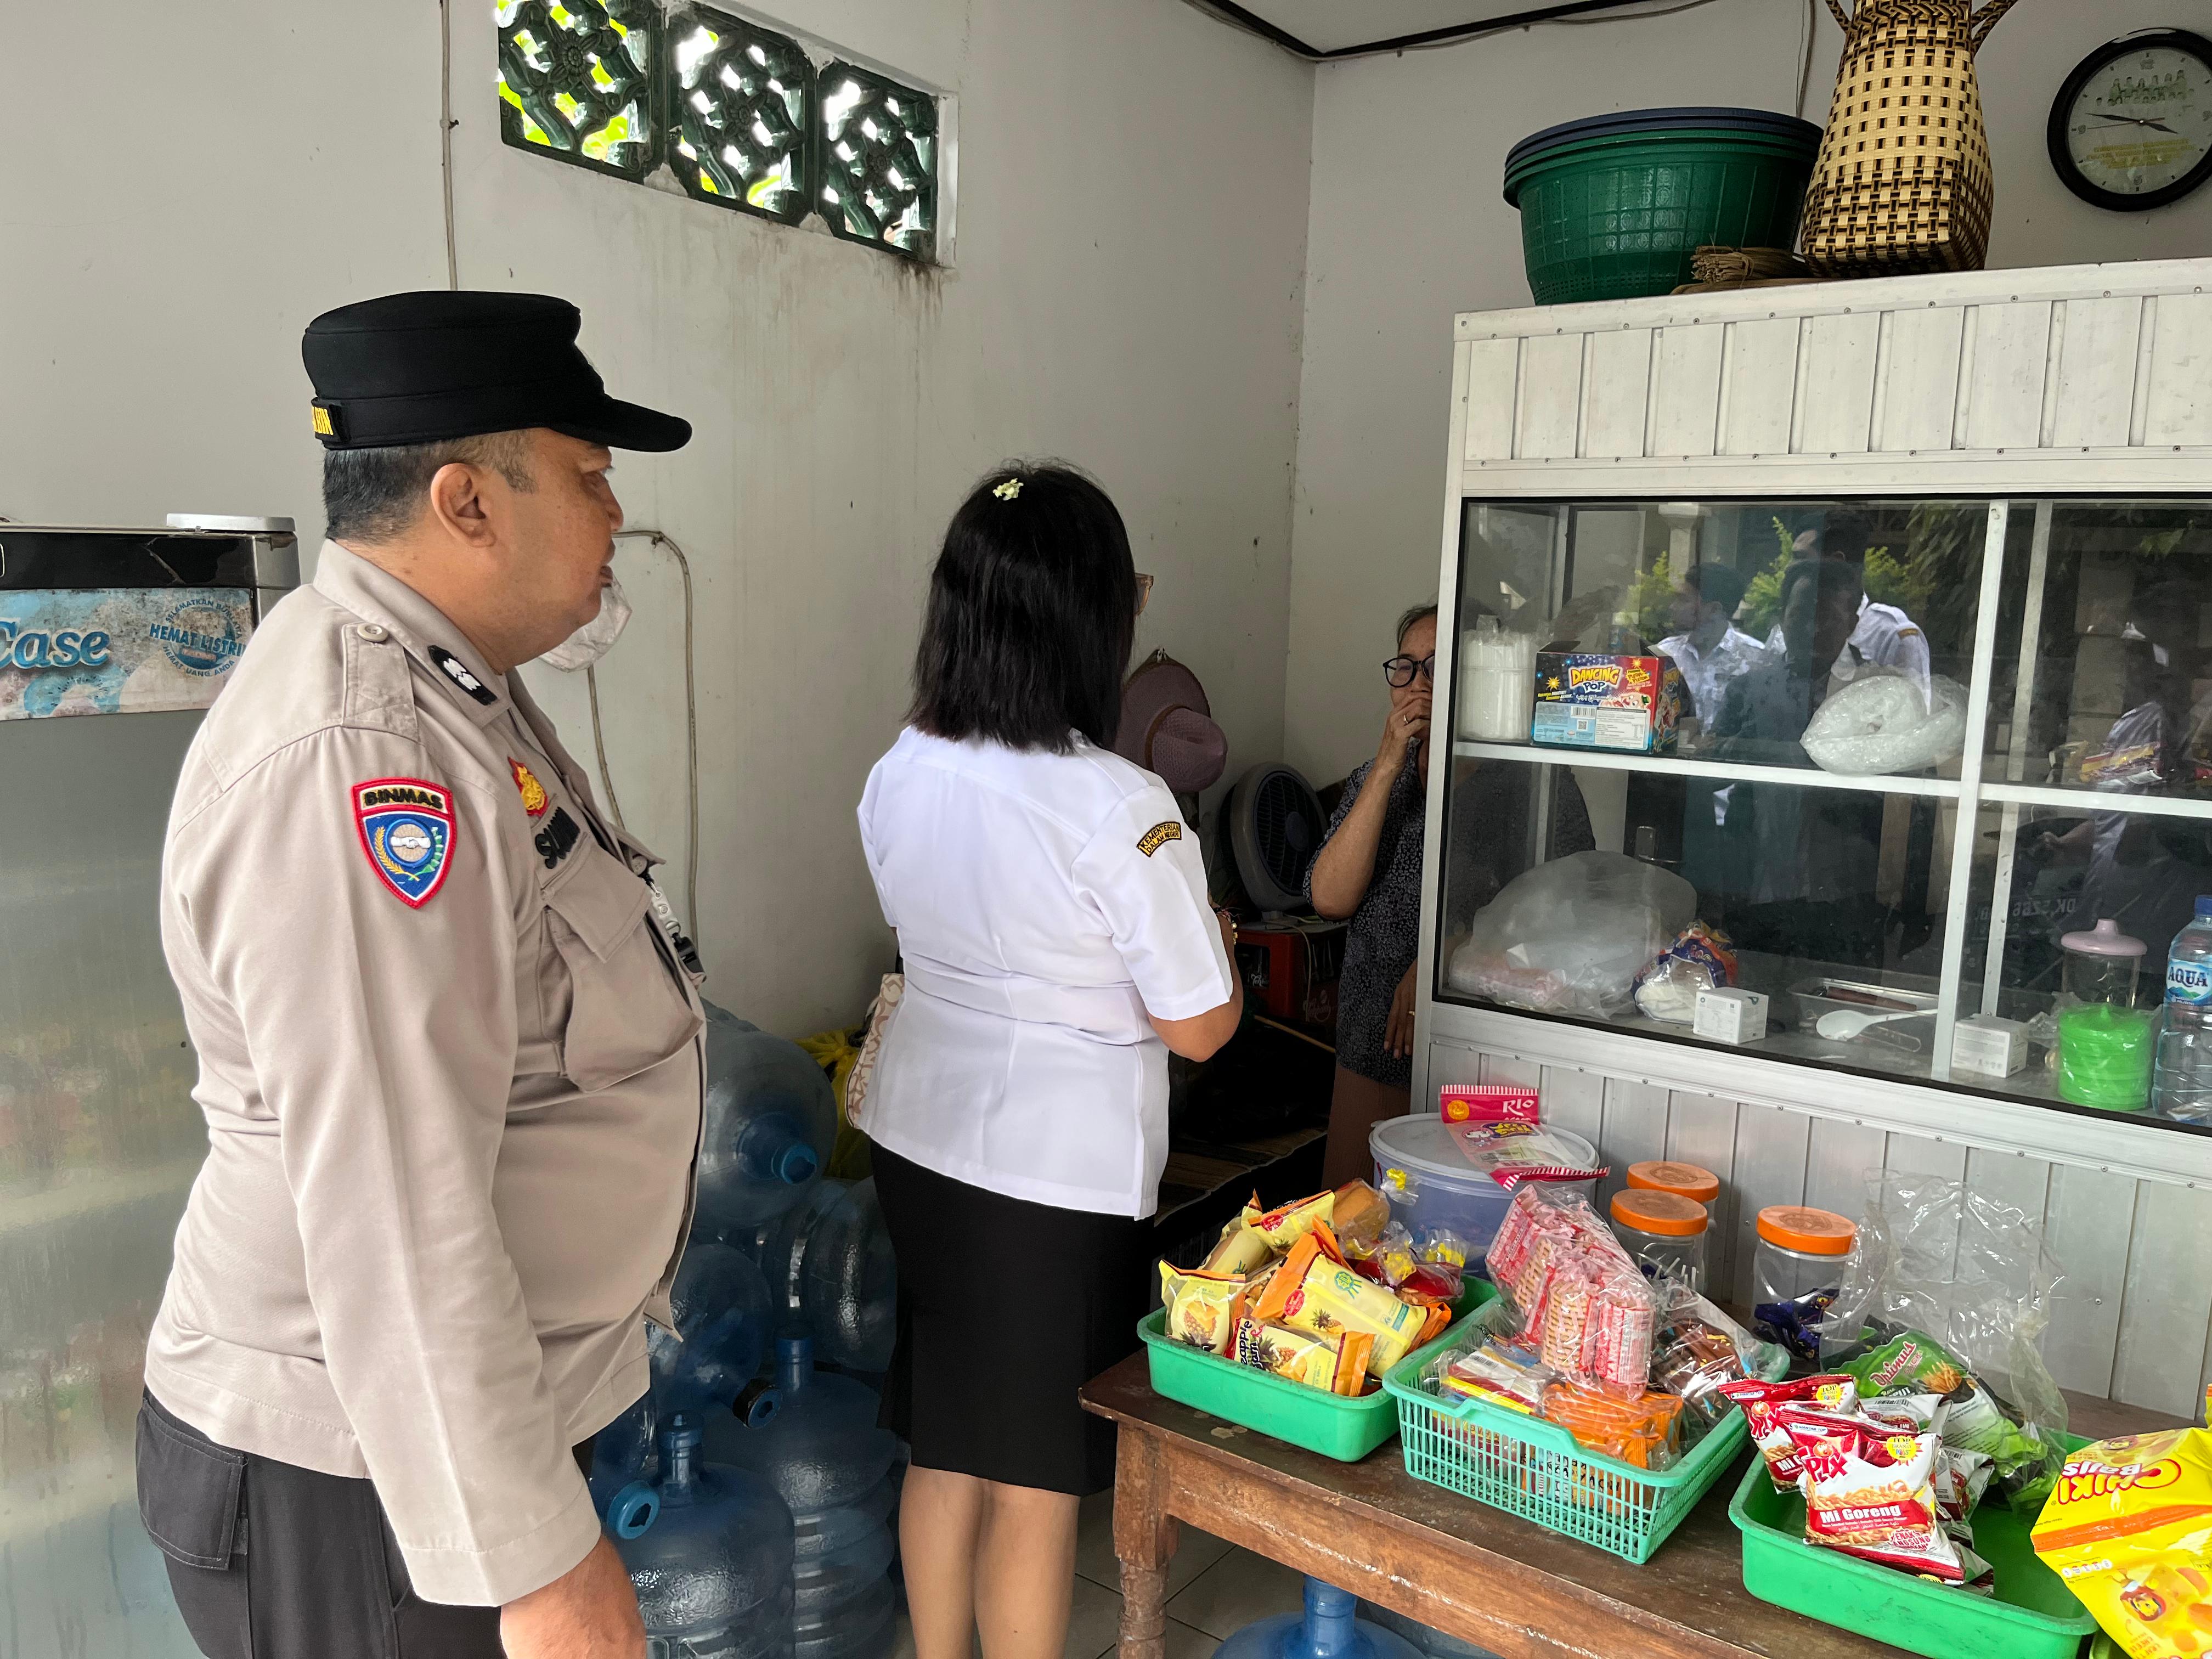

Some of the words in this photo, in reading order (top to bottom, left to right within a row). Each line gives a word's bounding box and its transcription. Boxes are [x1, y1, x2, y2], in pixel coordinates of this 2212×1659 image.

[166, 598, 213, 623] SELAMATKAN
[149, 623, 198, 646] HEMAT
[163, 646, 183, 669] HEMAT
[186, 668, 212, 677] UANG
[215, 659, 235, 675] ANDA
[1571, 666, 1621, 686] DANCING
[1583, 681, 1606, 691] POP
[364, 788, 443, 810] BINMAS
[1139, 823, 1180, 849] KEMENTERIAN
[1146, 834, 1164, 853] DALAM
[2168, 967, 2208, 988] AQUA
[1503, 1098, 1534, 1117] RIO
[1607, 1309, 1622, 1381] KANGGURU
[1870, 1341, 1917, 1388] Optimus
[1775, 1455, 1795, 1471] Mi
[2058, 1459, 2182, 1505] CHIKI
[1819, 1510, 1841, 1523] Mi
[1842, 1505, 1902, 1520] Goreng
[1895, 1530, 1915, 1541] ENAK
